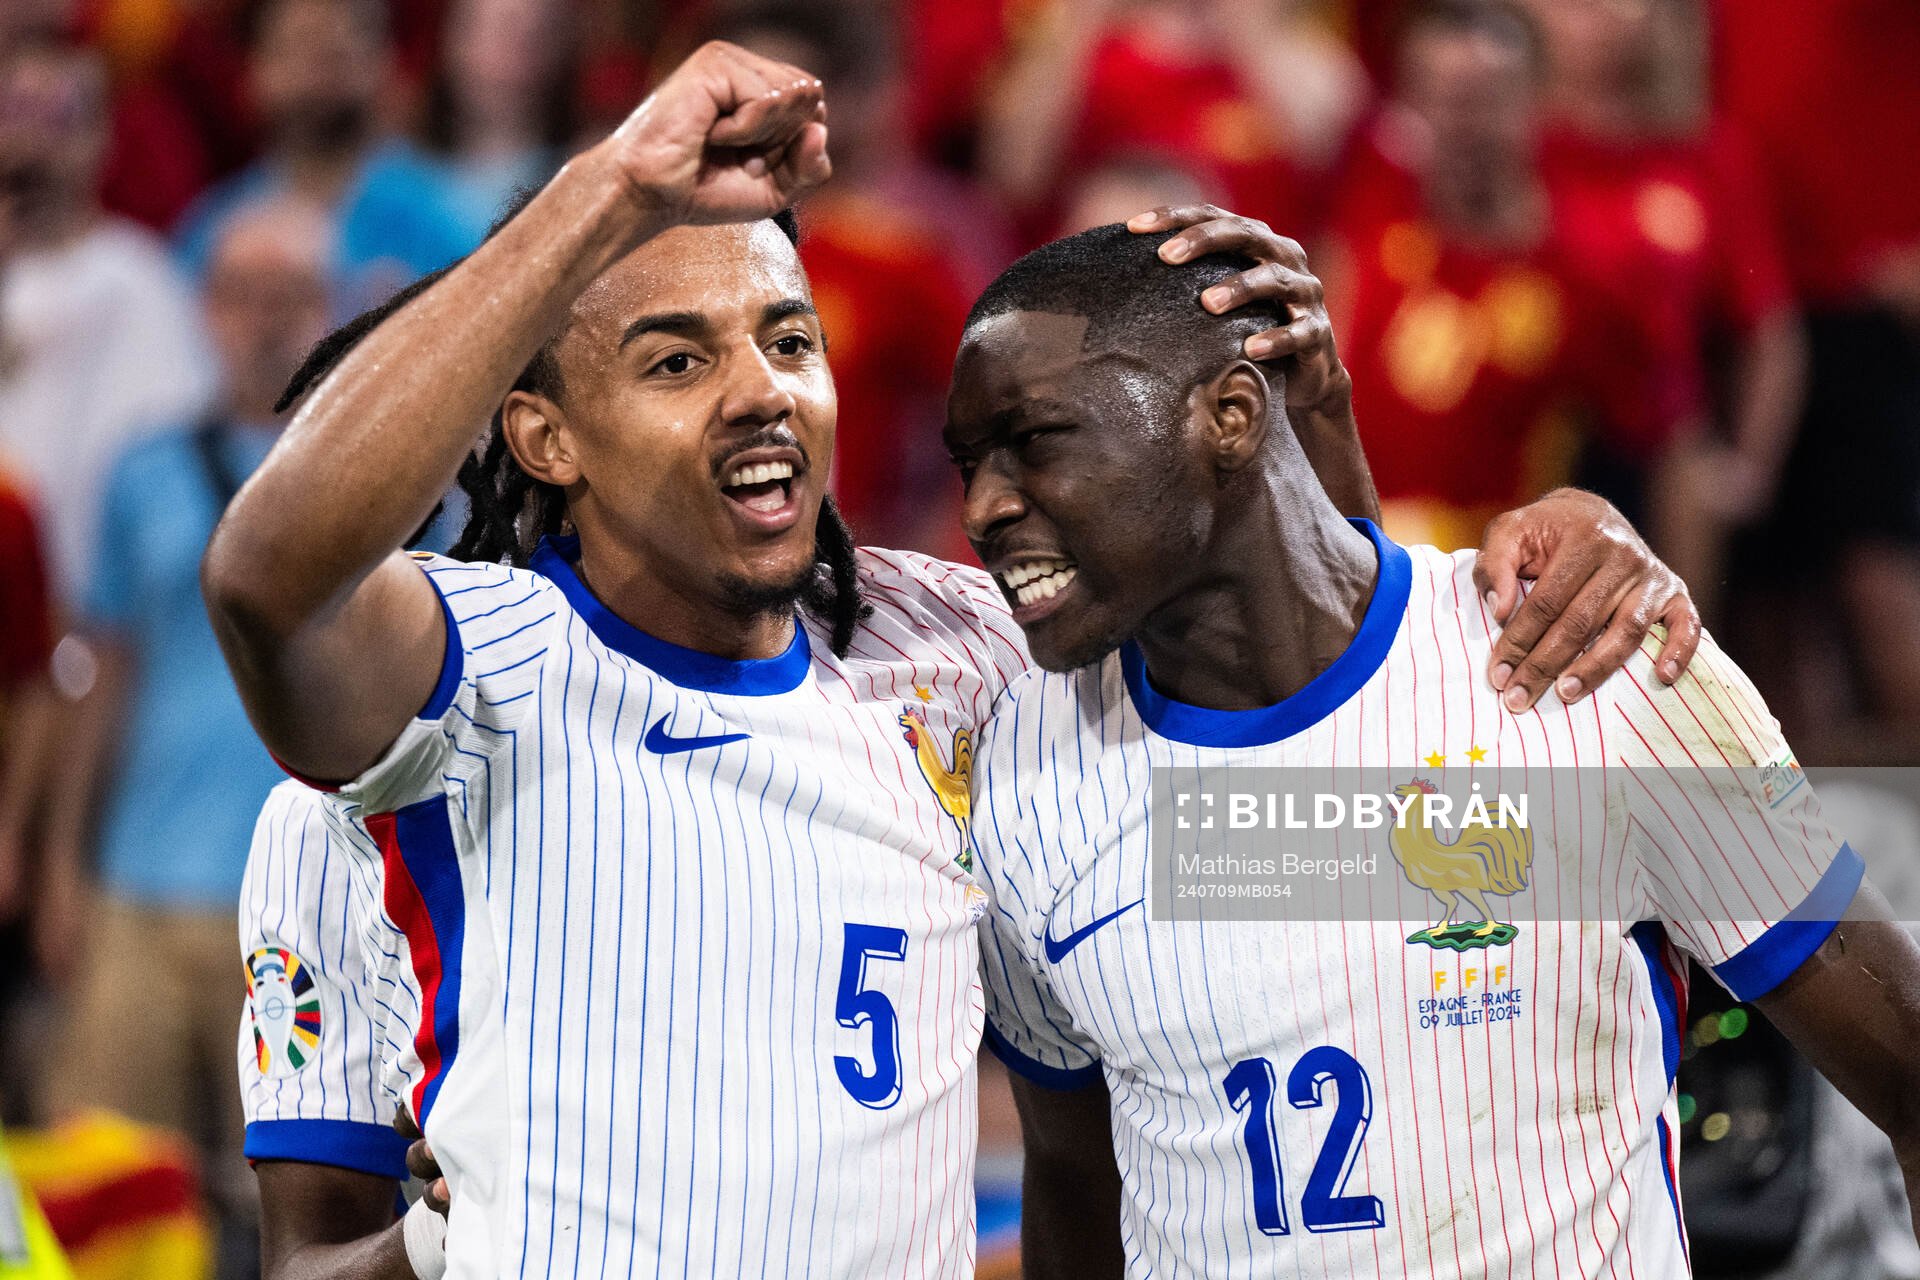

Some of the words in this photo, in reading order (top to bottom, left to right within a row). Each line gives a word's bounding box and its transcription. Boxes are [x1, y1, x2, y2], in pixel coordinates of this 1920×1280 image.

[833, 922, 909, 1111] 5
[1418, 995, 1468, 1013] ESPAGNE
[1481, 988, 1522, 1008] FRANCE
[1419, 1014, 1440, 1030] 09
[1444, 1009, 1484, 1027] JUILLET
[1488, 1005, 1521, 1022] 2024
[1222, 1045, 1386, 1236] 12
